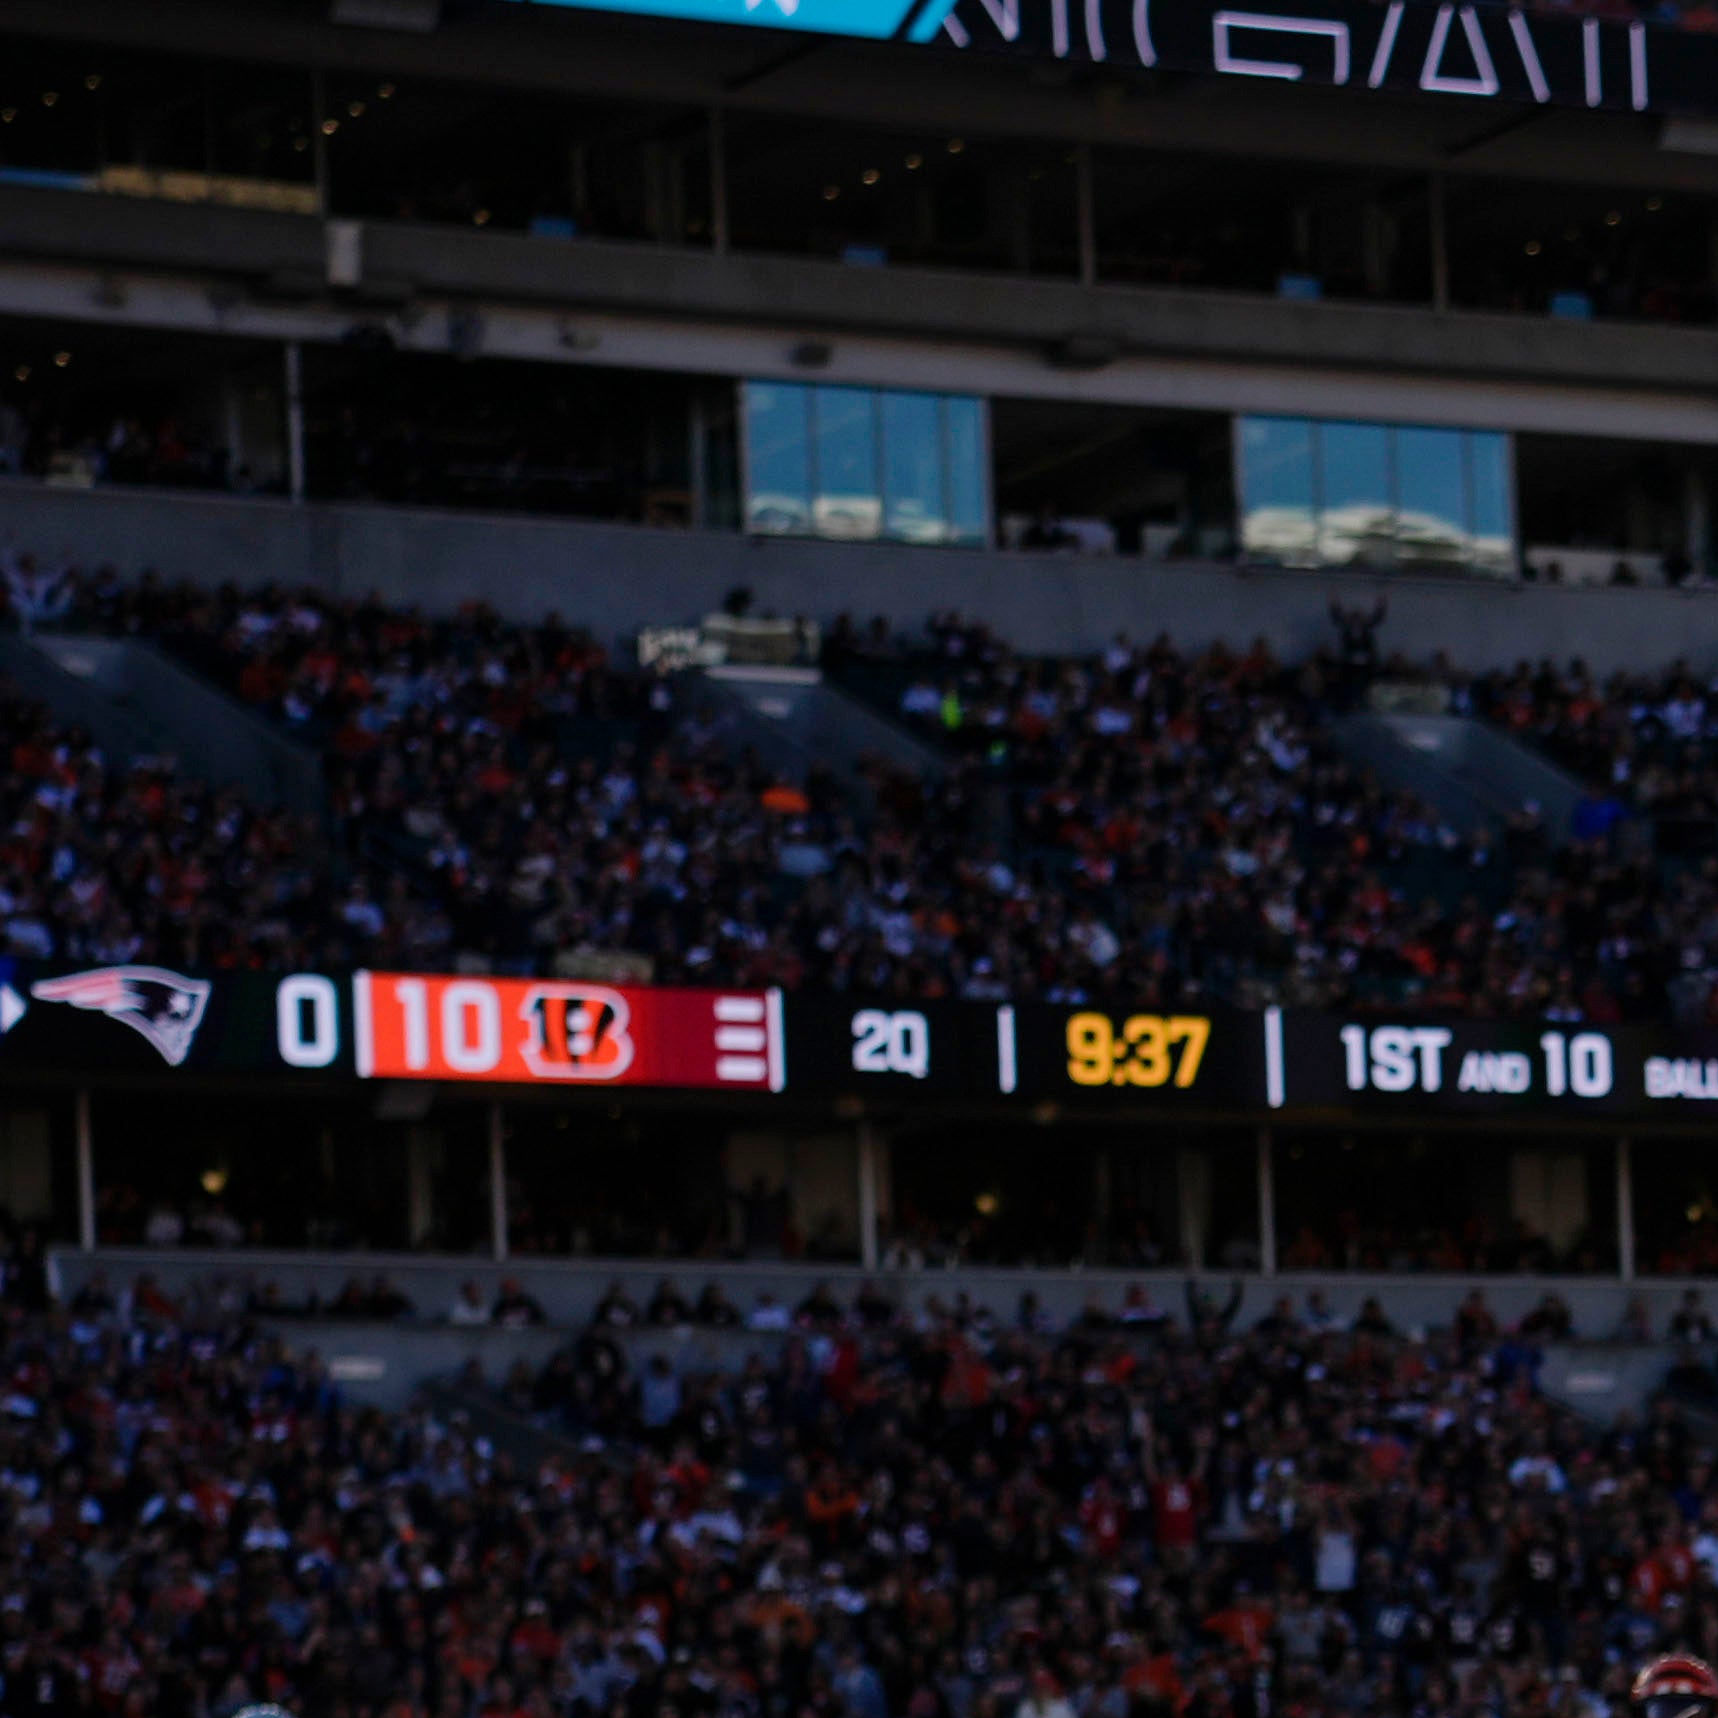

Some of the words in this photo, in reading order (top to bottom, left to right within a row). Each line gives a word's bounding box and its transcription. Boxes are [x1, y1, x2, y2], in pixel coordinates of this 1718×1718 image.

[276, 972, 338, 1068] 0
[395, 975, 501, 1074] 10
[1066, 1010, 1211, 1089] 9:37
[1340, 1022, 1453, 1093] 1ST
[1456, 1050, 1531, 1095] AND
[1539, 1030, 1614, 1098] 10
